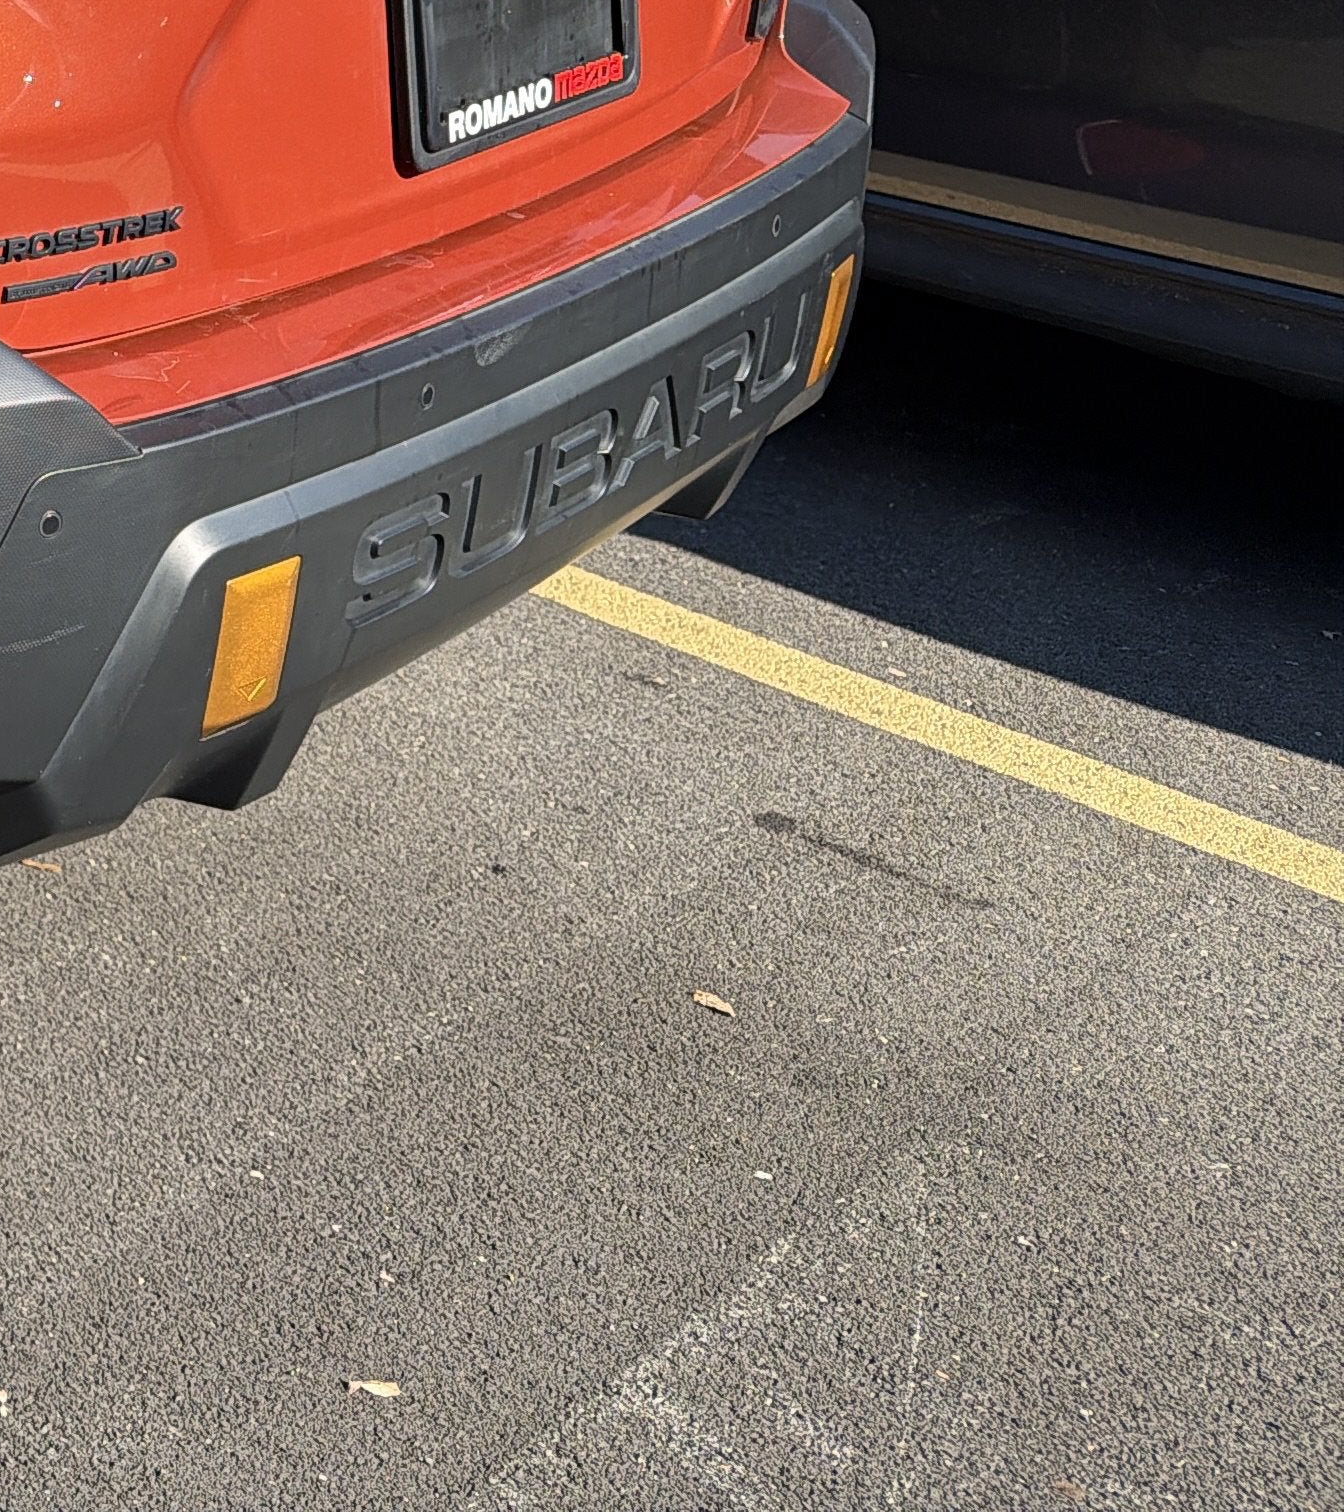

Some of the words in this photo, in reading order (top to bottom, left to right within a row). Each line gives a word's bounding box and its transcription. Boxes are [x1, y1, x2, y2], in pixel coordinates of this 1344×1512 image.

[447, 77, 553, 143] ROMANO
[553, 53, 624, 103] mazda
[74, 250, 178, 289] AWD
[345, 291, 808, 628] SUBARU
